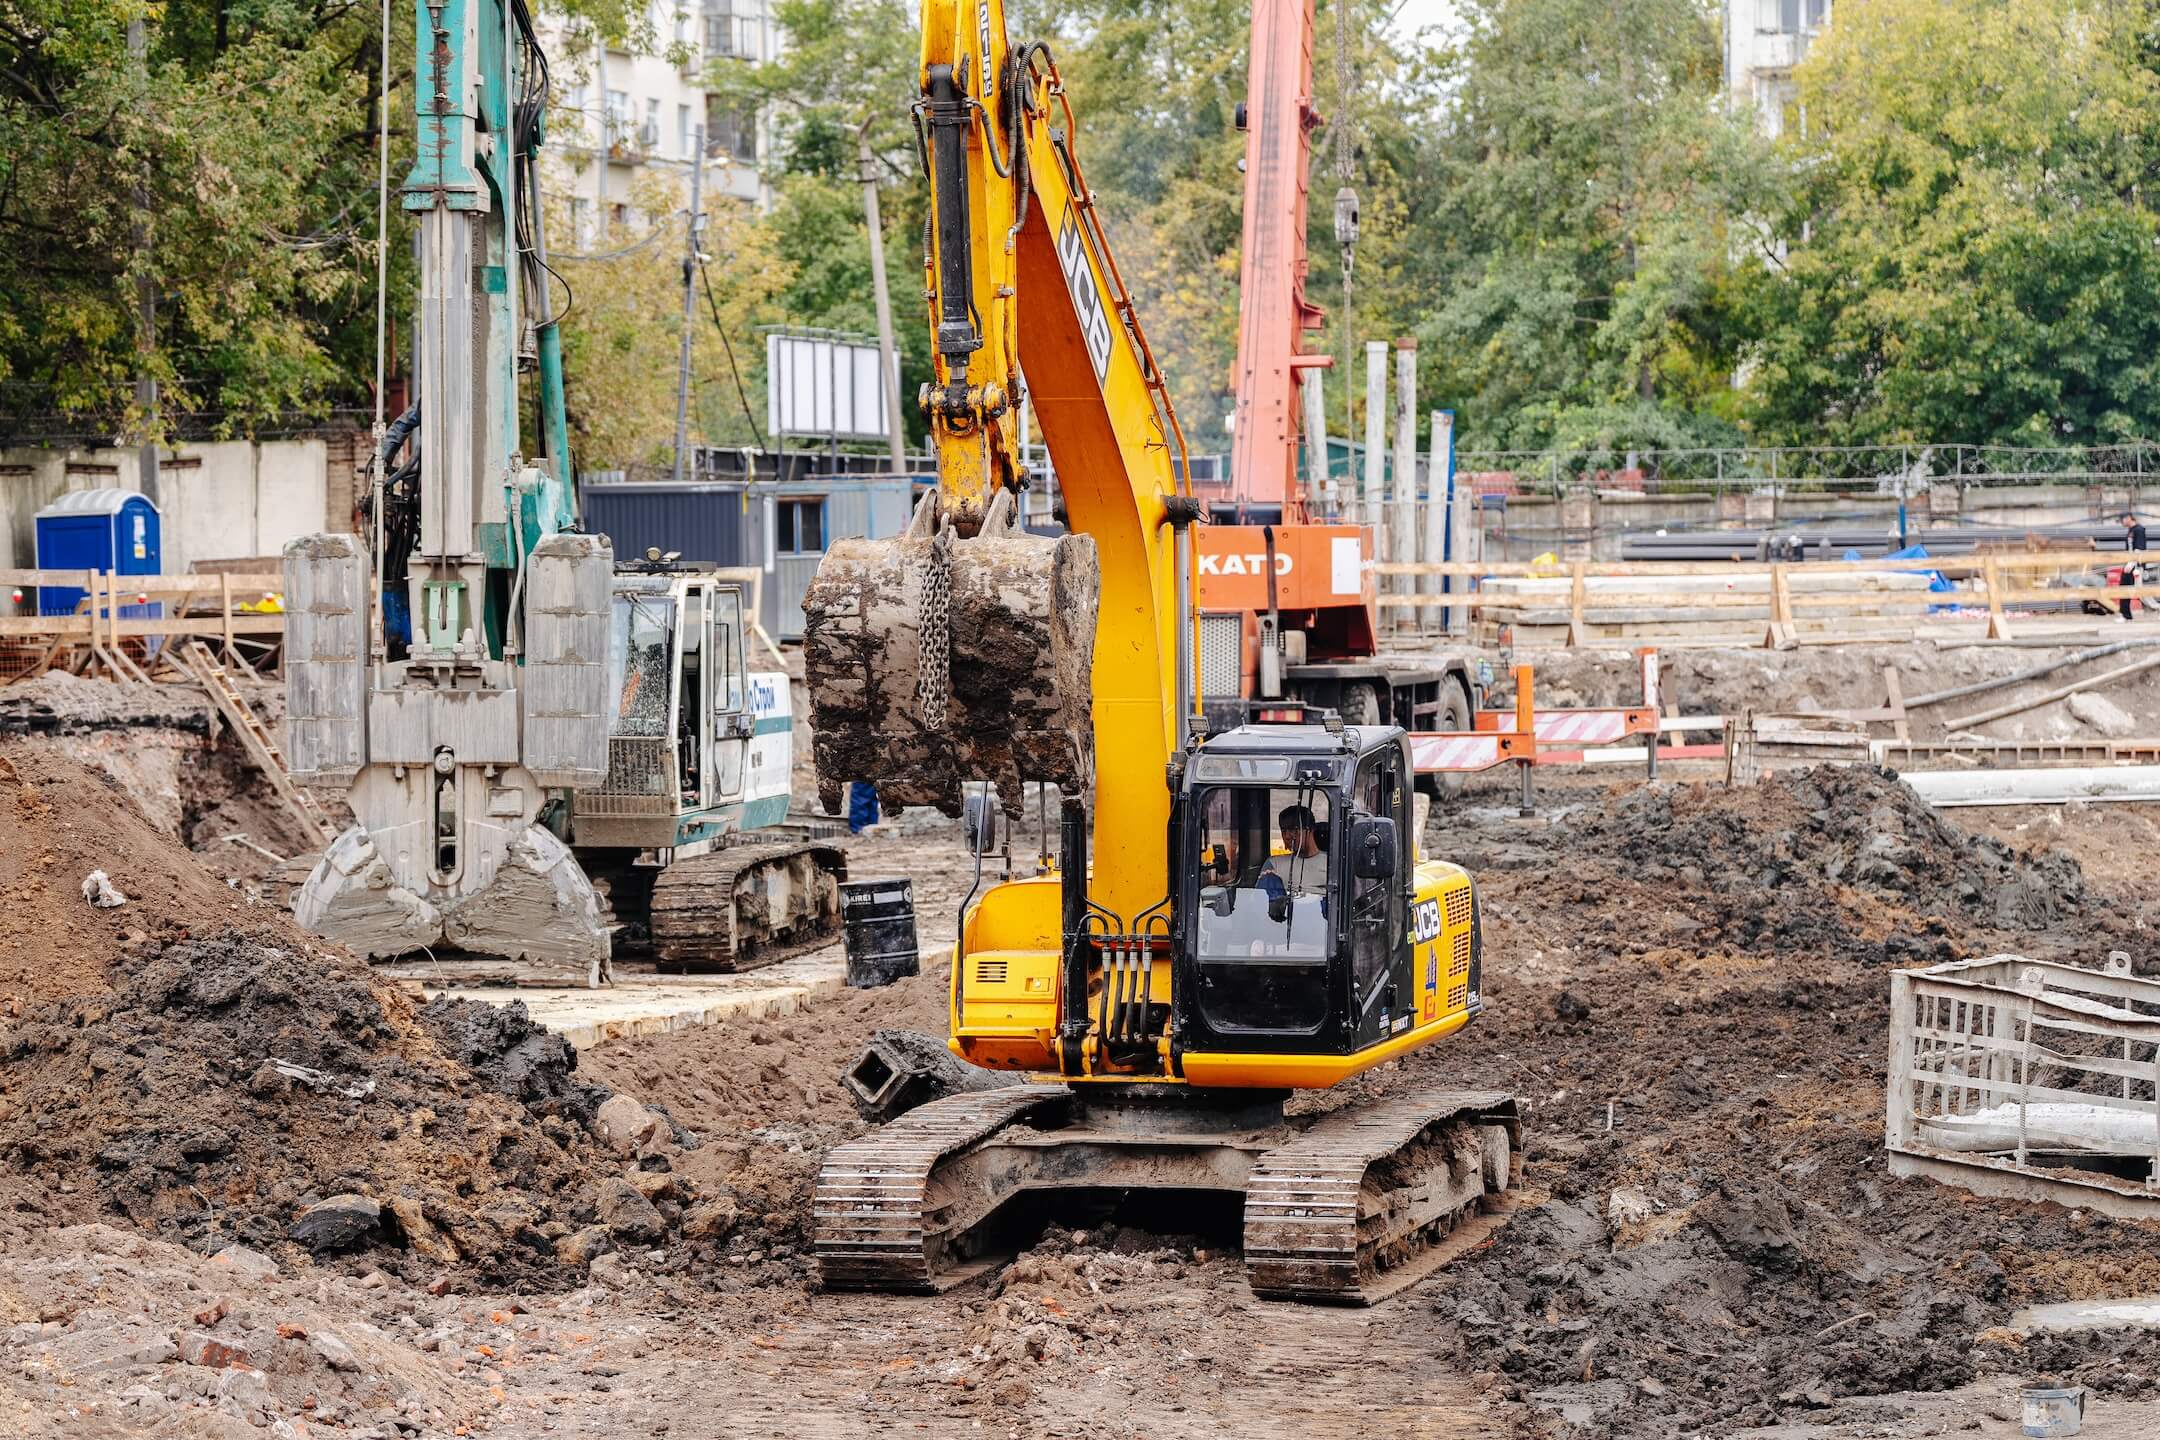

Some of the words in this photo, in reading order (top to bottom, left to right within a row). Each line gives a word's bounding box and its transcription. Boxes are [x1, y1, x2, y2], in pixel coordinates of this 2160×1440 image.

[1060, 228, 1111, 379] JCB
[1198, 553, 1293, 576] KATO
[1414, 901, 1440, 942] JCB
